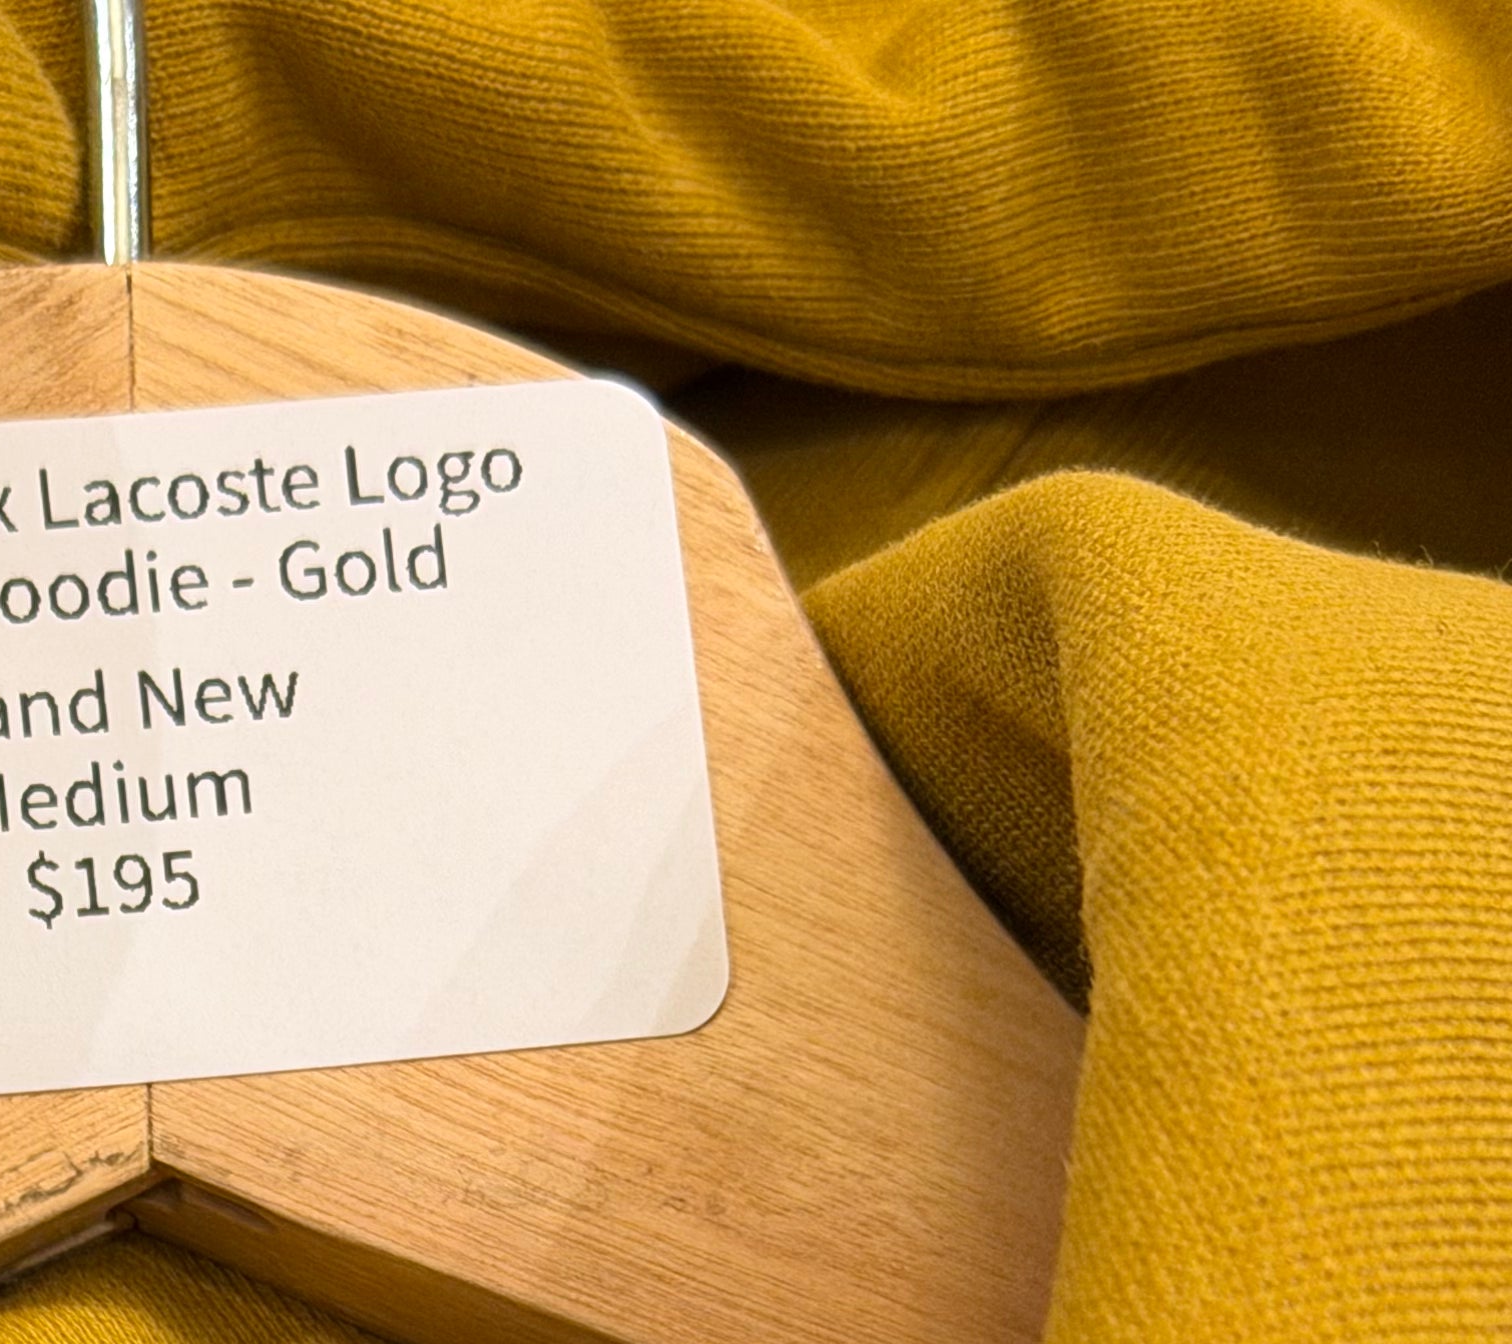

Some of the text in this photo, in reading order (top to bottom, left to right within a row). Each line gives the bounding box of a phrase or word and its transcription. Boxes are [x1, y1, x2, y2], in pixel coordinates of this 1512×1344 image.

[37, 454, 322, 530] Lacoste
[343, 441, 525, 518] Logo
[230, 576, 255, 591] -
[277, 523, 451, 602] Gold
[137, 664, 301, 731] New
[25, 848, 201, 931] $195
